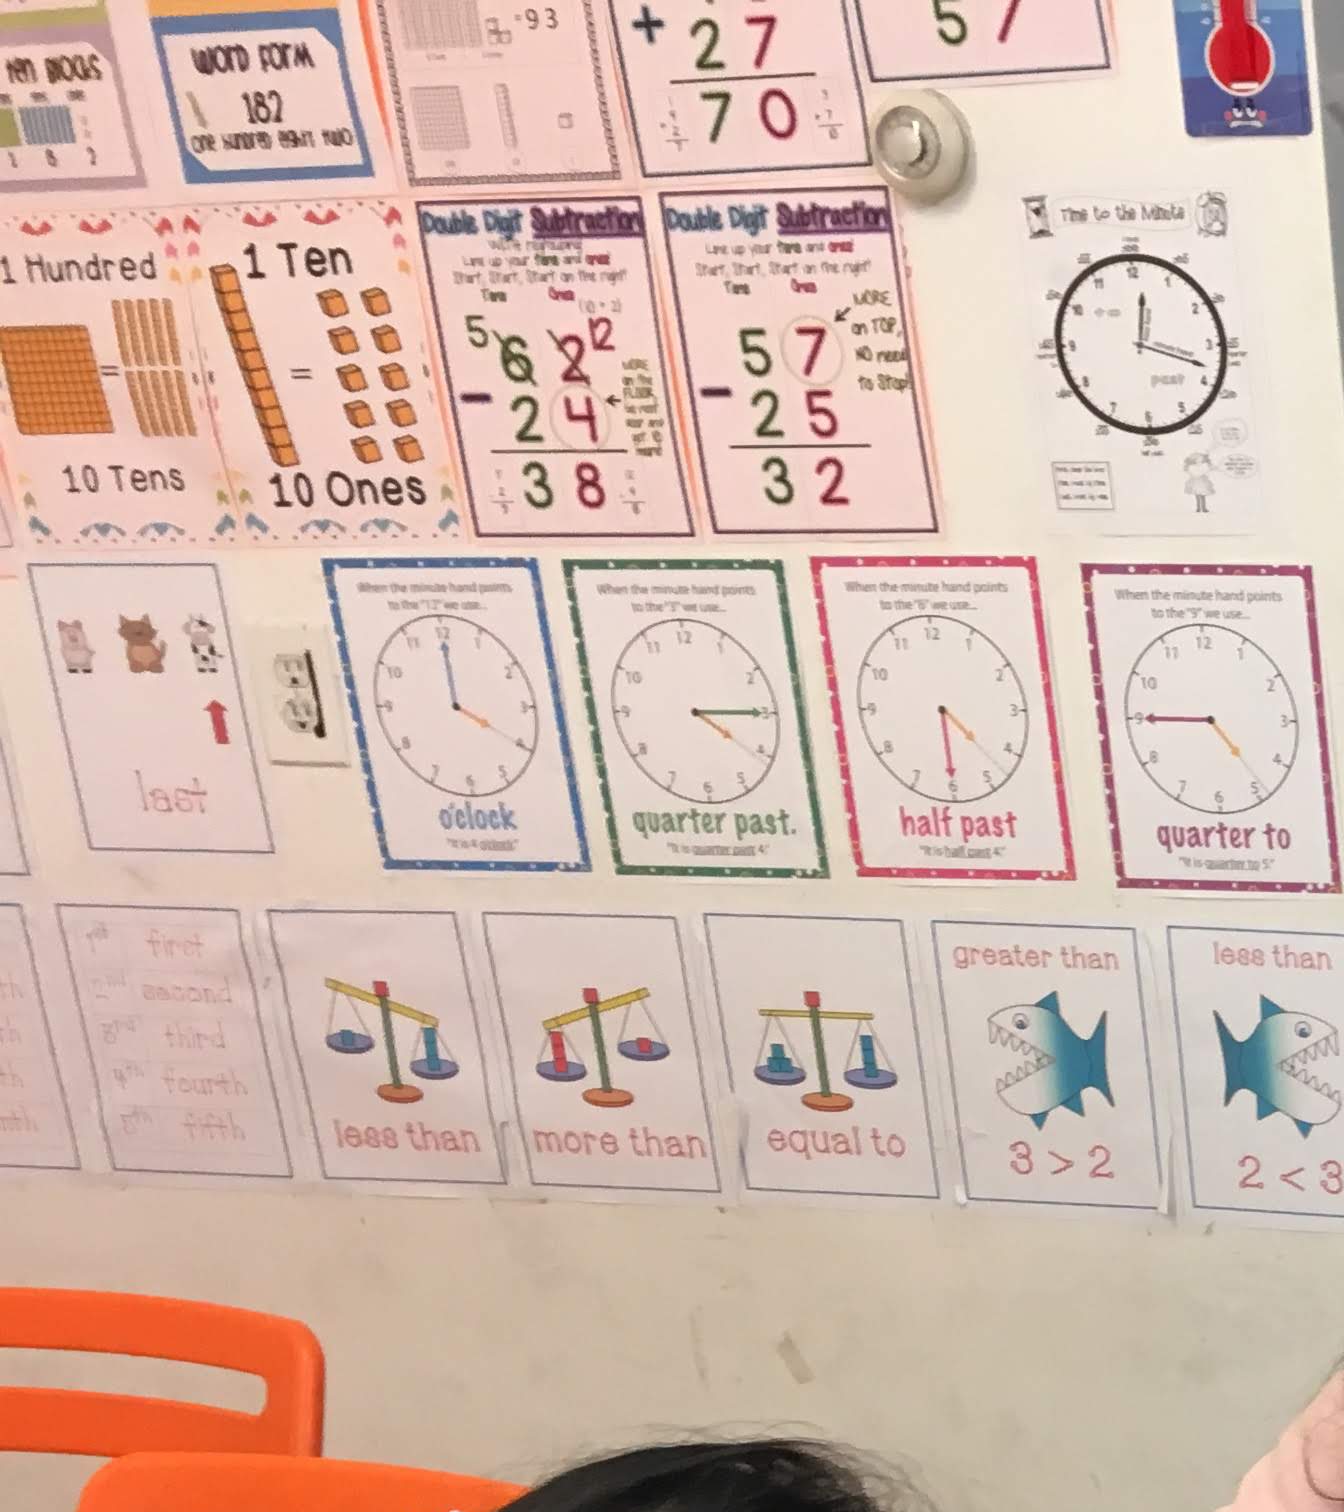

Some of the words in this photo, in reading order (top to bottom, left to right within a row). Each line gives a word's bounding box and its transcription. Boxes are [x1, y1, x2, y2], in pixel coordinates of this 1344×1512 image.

[241, 89, 283, 125] 182
[665, 207, 723, 232] Double
[728, 204, 768, 236] Digit
[776, 201, 891, 229] Subtraction
[1093, 205, 1110, 221] to
[1115, 204, 1137, 221] the
[26, 252, 158, 284] Hundred
[277, 242, 354, 279] Ten
[465, 314, 489, 348] 5
[63, 464, 100, 494] 10
[107, 463, 186, 494] Tens
[271, 473, 314, 508] 10
[326, 471, 427, 507] Ones
[761, 457, 849, 505] 32
[134, 769, 209, 816] last
[632, 808, 726, 839] quarter
[734, 808, 797, 841] past.
[899, 805, 953, 837] half
[960, 811, 1017, 843] past
[1157, 822, 1256, 854] quarter
[1262, 822, 1292, 850] to
[953, 942, 1053, 972] greater
[1060, 945, 1120, 972] than
[1212, 941, 1264, 968] less
[1271, 944, 1333, 972] than
[333, 1117, 399, 1149] less
[405, 1120, 482, 1153] than
[532, 1127, 620, 1157] more
[628, 1127, 708, 1159] than
[767, 1126, 864, 1162] equal
[871, 1128, 907, 1158] to
[1009, 1140, 1034, 1178] 3
[1088, 1144, 1116, 1180] 2
[1237, 1154, 1265, 1190] 2
[1318, 1159, 1344, 1196] 3
